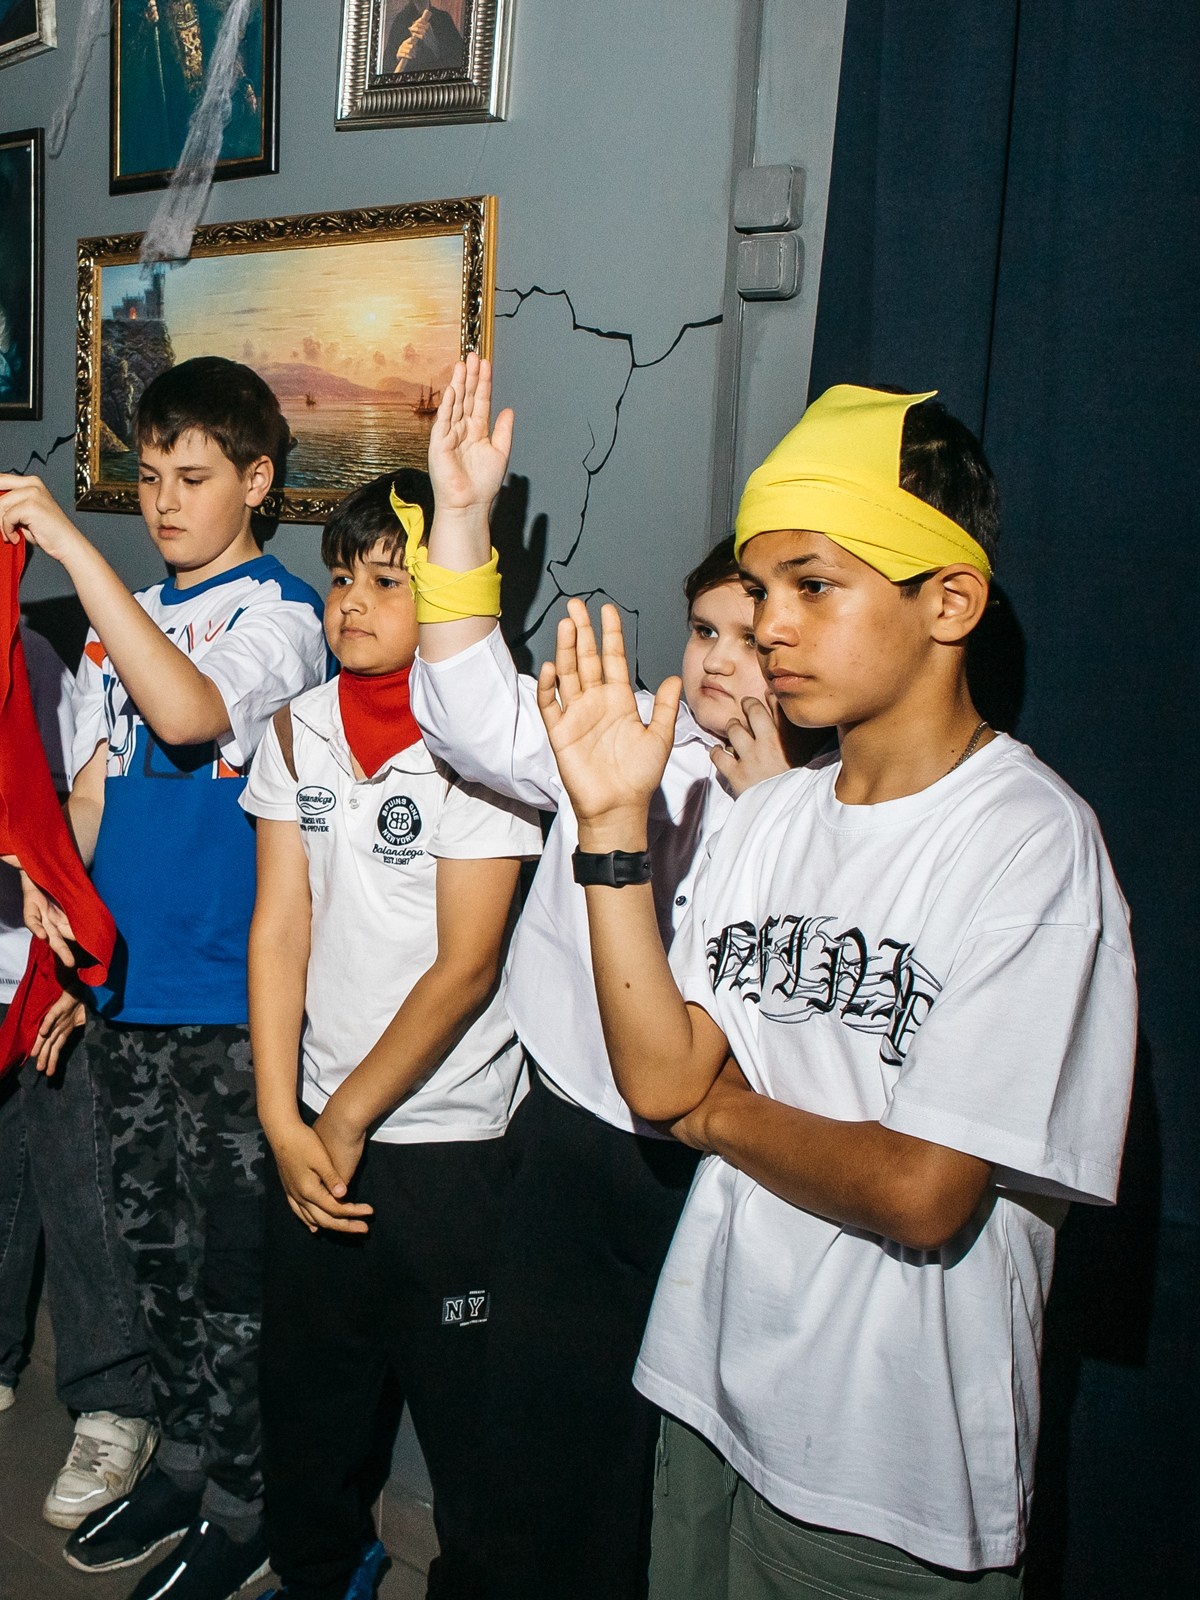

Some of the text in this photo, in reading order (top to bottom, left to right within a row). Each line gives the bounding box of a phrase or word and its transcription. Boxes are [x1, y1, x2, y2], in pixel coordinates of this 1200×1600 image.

[382, 798, 420, 821] BRUINS ONE
[373, 843, 425, 859] Balandega
